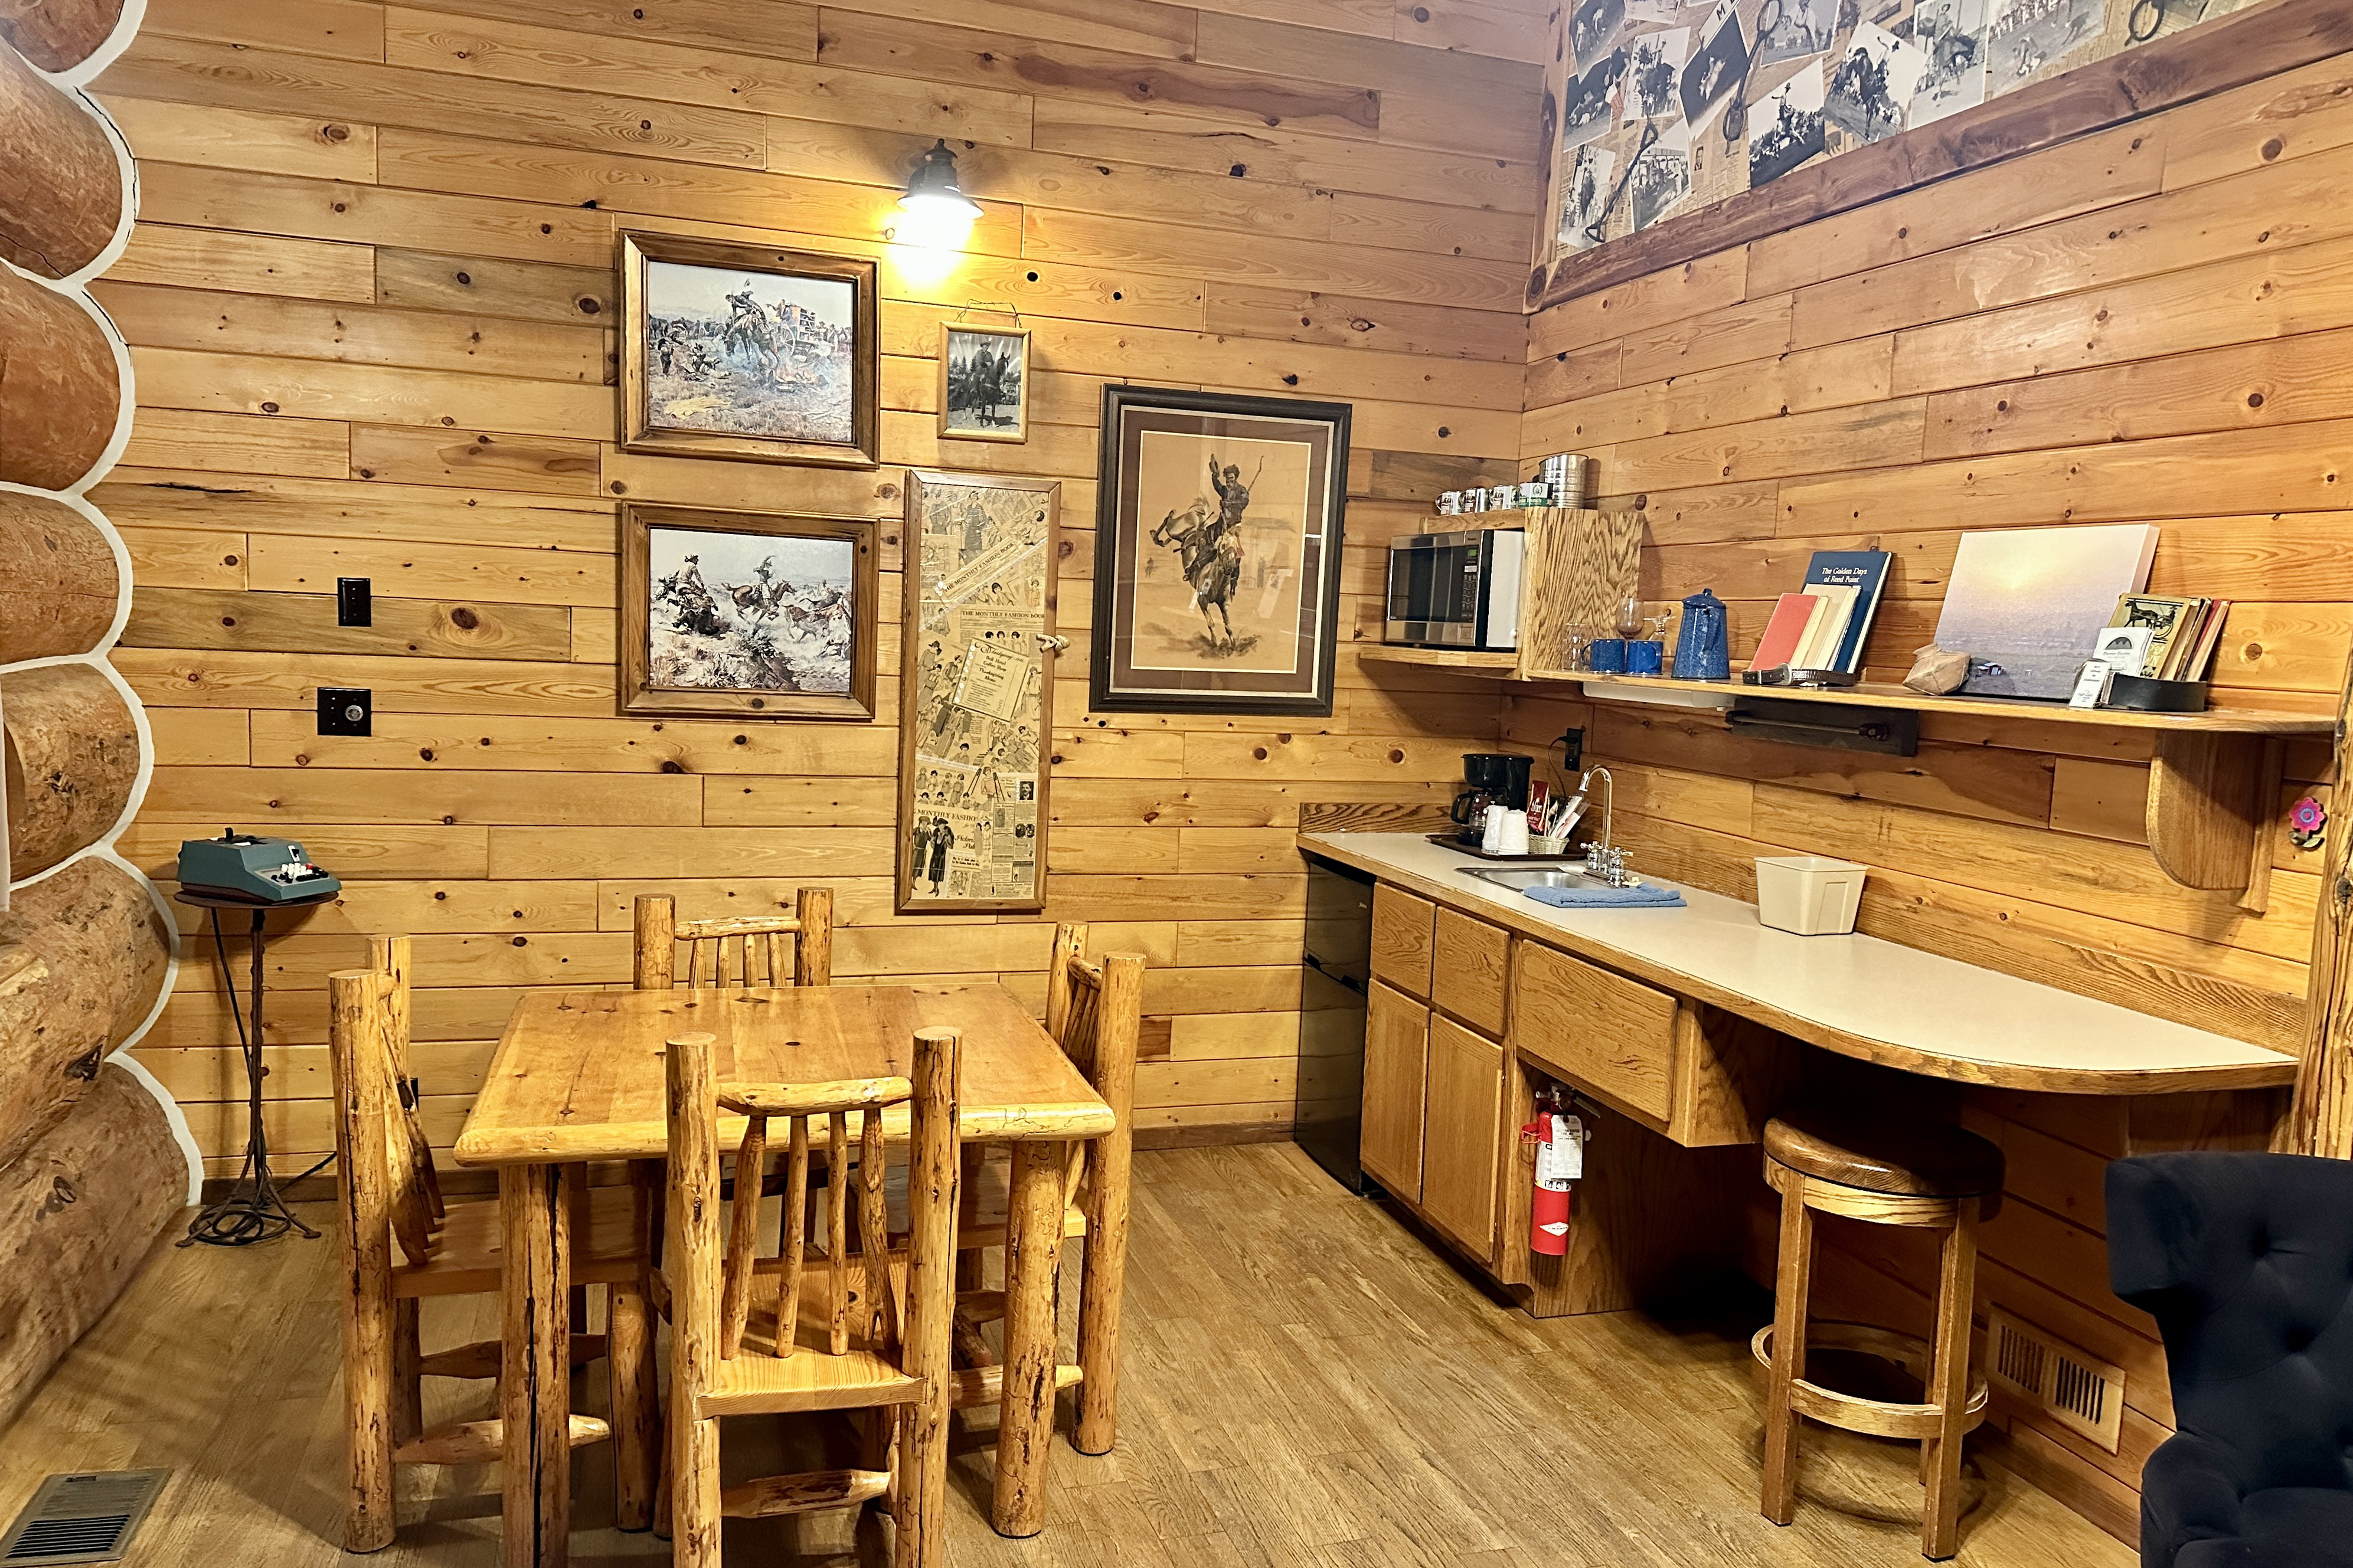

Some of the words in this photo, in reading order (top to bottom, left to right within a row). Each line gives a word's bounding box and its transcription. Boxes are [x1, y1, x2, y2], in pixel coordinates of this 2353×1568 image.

[955, 566, 979, 585] MONTHLY
[979, 552, 1001, 568] FASHION
[1000, 542, 1015, 554] BOOK
[1853, 567, 1868, 576] Days
[917, 808, 950, 819] MONTHLY
[952, 813, 977, 821] FASHIO
